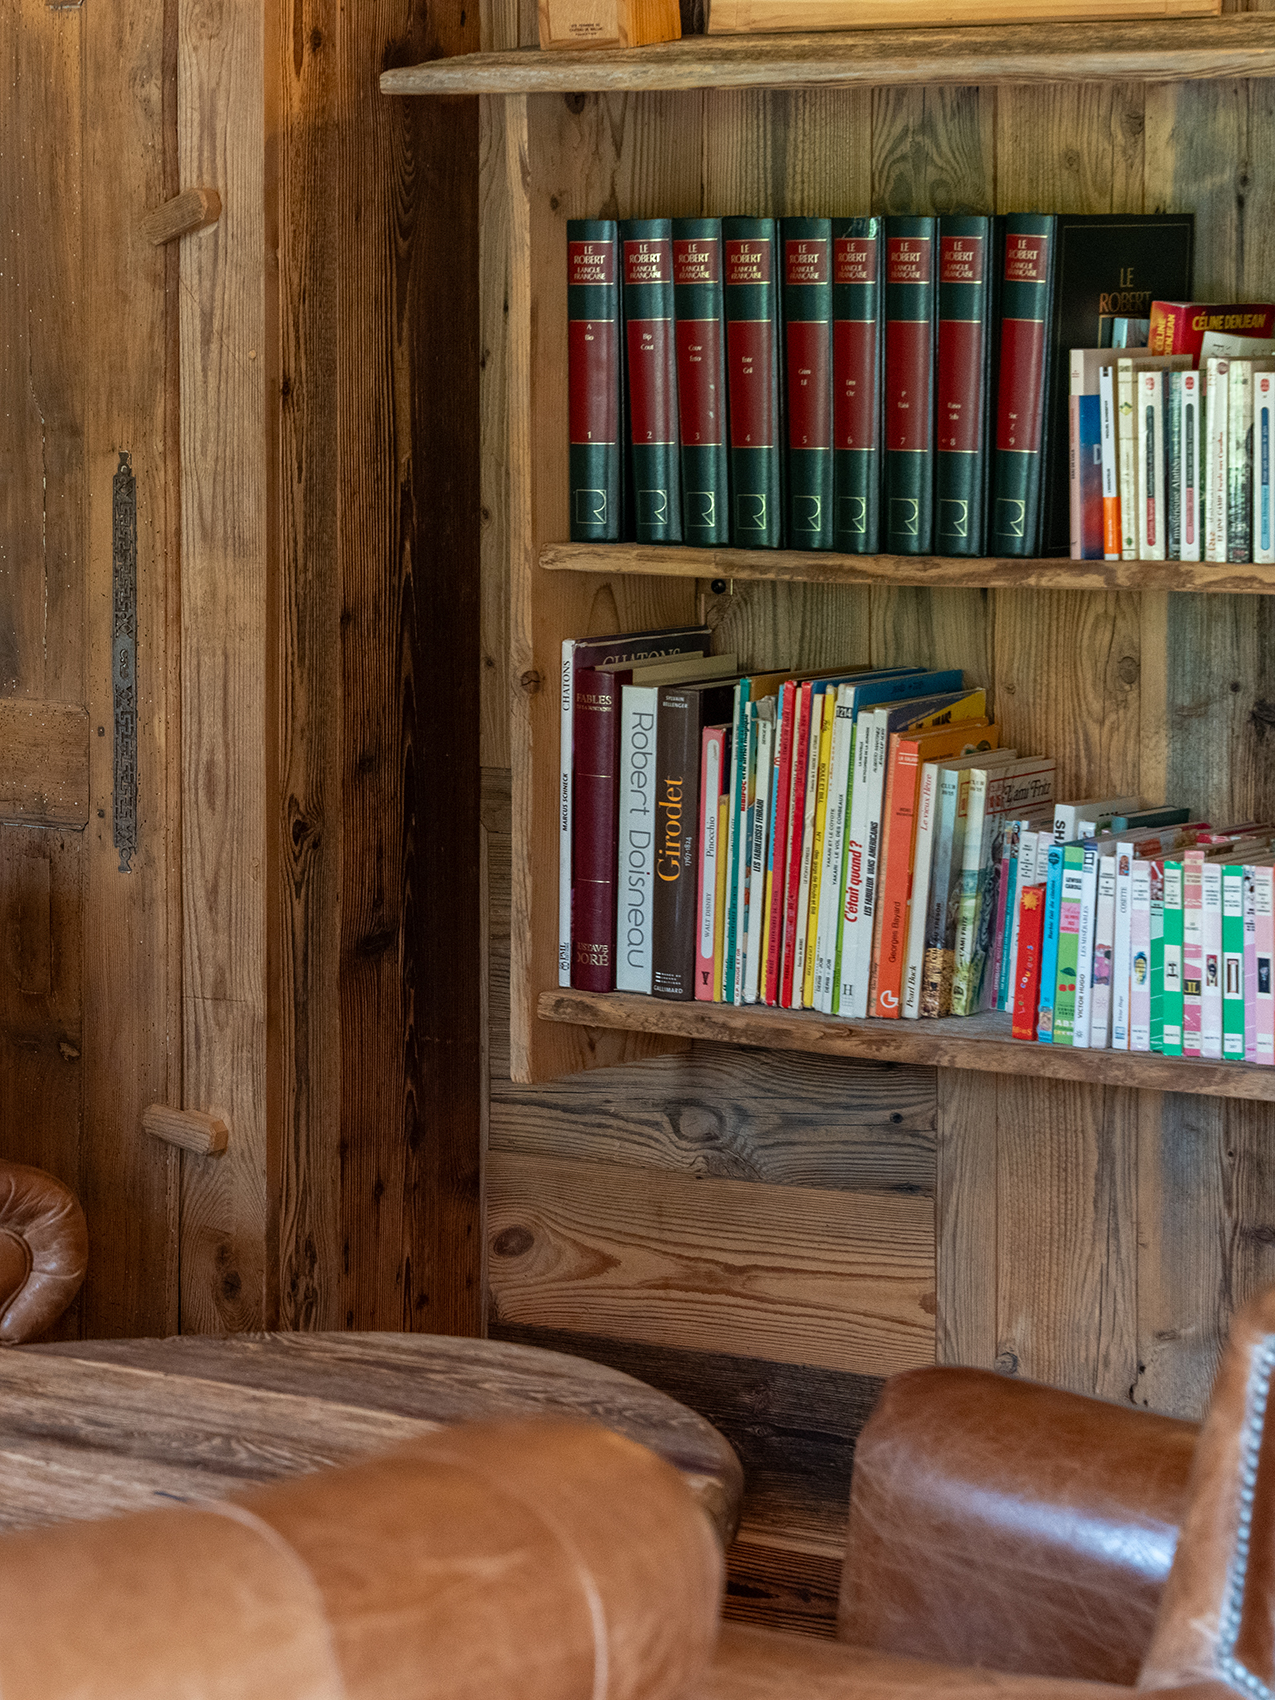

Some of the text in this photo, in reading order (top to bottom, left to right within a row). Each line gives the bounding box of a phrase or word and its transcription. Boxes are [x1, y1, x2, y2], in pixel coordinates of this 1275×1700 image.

[639, 244, 648, 253] LE
[688, 244, 697, 253] LE
[741, 245, 750, 254] LE
[799, 245, 807, 253] LE
[847, 243, 856, 252] LE
[901, 242, 909, 252] LE
[954, 242, 963, 251] LE
[1018, 240, 1027, 249] LE
[584, 246, 593, 254] LE
[1009, 250, 1038, 260] ROBERT
[574, 255, 605, 264] ROBERT
[629, 253, 661, 263] ROBERT
[679, 253, 709, 262] ROBERT
[731, 254, 762, 263] ROBERT
[789, 254, 819, 263] ROBERT
[838, 253, 867, 262] ROBERT
[891, 252, 921, 262] ROBERT
[944, 252, 974, 261] ROBERT
[1120, 268, 1134, 288] LE
[1099, 292, 1152, 313] ROBERT
[1192, 311, 1266, 331] CÉLINE DENJEAN
[1156, 317, 1167, 351] CÉLINE
[1164, 314, 1175, 356] DENJEAN
[587, 431, 591, 439] 1
[647, 431, 652, 439] 2
[695, 432, 700, 440] 3
[745, 434, 751, 442] 4
[950, 438, 956, 446] 8
[1009, 438, 1015, 446] 9
[562, 660, 570, 711] CHATONS
[577, 694, 612, 705] FABLES
[1005, 782, 1029, 803] L'ami
[1029, 778, 1052, 797] Fritz
[836, 794, 844, 825] CORBEAUX
[922, 798, 931, 817] vieux
[657, 776, 684, 882] Girodet
[921, 819, 928, 831] Le
[627, 712, 654, 969] Robert Doisneau
[707, 816, 716, 858] Pinocchio
[753, 798, 764, 873] LES FABULEUSES FERRARI
[849, 840, 862, 849] ?
[684, 836, 693, 868] 1767-1824
[847, 849, 863, 886] quand
[864, 822, 878, 917] LES FABULEUX VANS AMERICAINS
[813, 875, 819, 883] de
[844, 887, 859, 923] C'était
[1049, 900, 1055, 908] du
[1080, 906, 1089, 945] MISÉRABLES
[889, 902, 901, 963] Georges Bayard
[737, 948, 741, 957] OR
[1018, 945, 1034, 1014] Les couleurs
[653, 985, 684, 994] GALLIMARD
[906, 965, 917, 1008] Pearl Buck
